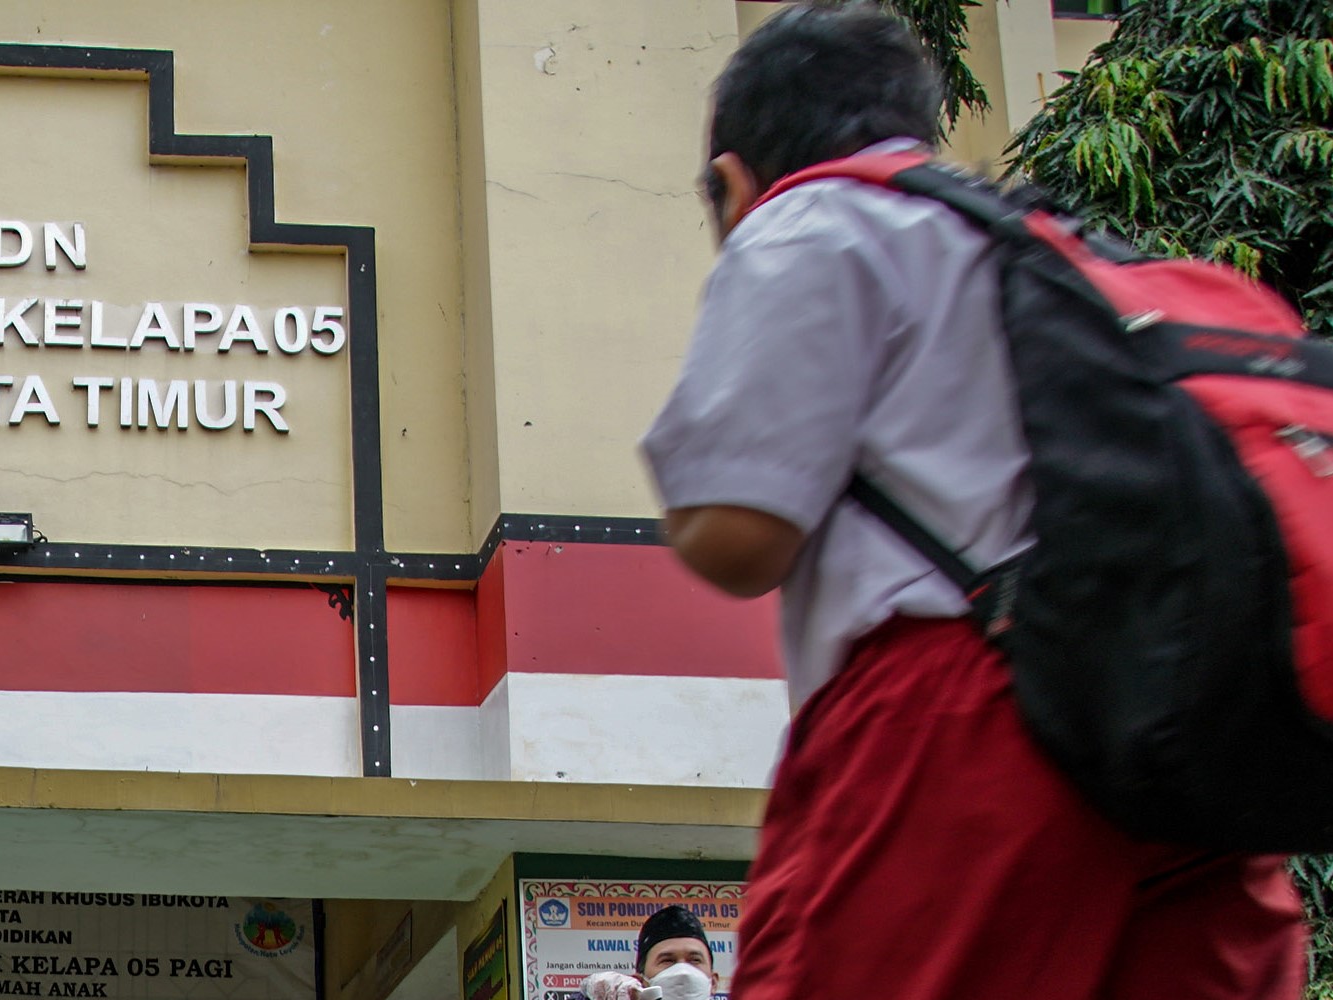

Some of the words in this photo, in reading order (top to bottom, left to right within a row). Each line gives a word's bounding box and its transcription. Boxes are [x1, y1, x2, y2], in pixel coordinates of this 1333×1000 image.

[73, 376, 290, 434] TIMUR
[51, 891, 135, 907] KHUSUS
[142, 894, 229, 908] IBUKOTA
[578, 902, 606, 917] SDN
[721, 904, 739, 918] 05
[586, 919, 629, 928] Kecamatan
[707, 921, 730, 929] Timur
[587, 939, 629, 952] KAWAL
[10, 955, 119, 976] KELAPA
[127, 957, 160, 977] 05
[169, 958, 233, 979] PAGI
[546, 961, 574, 971] Jangan
[576, 961, 612, 970] diamkan
[613, 962, 630, 970] aksi
[48, 982, 109, 998] ANAK
